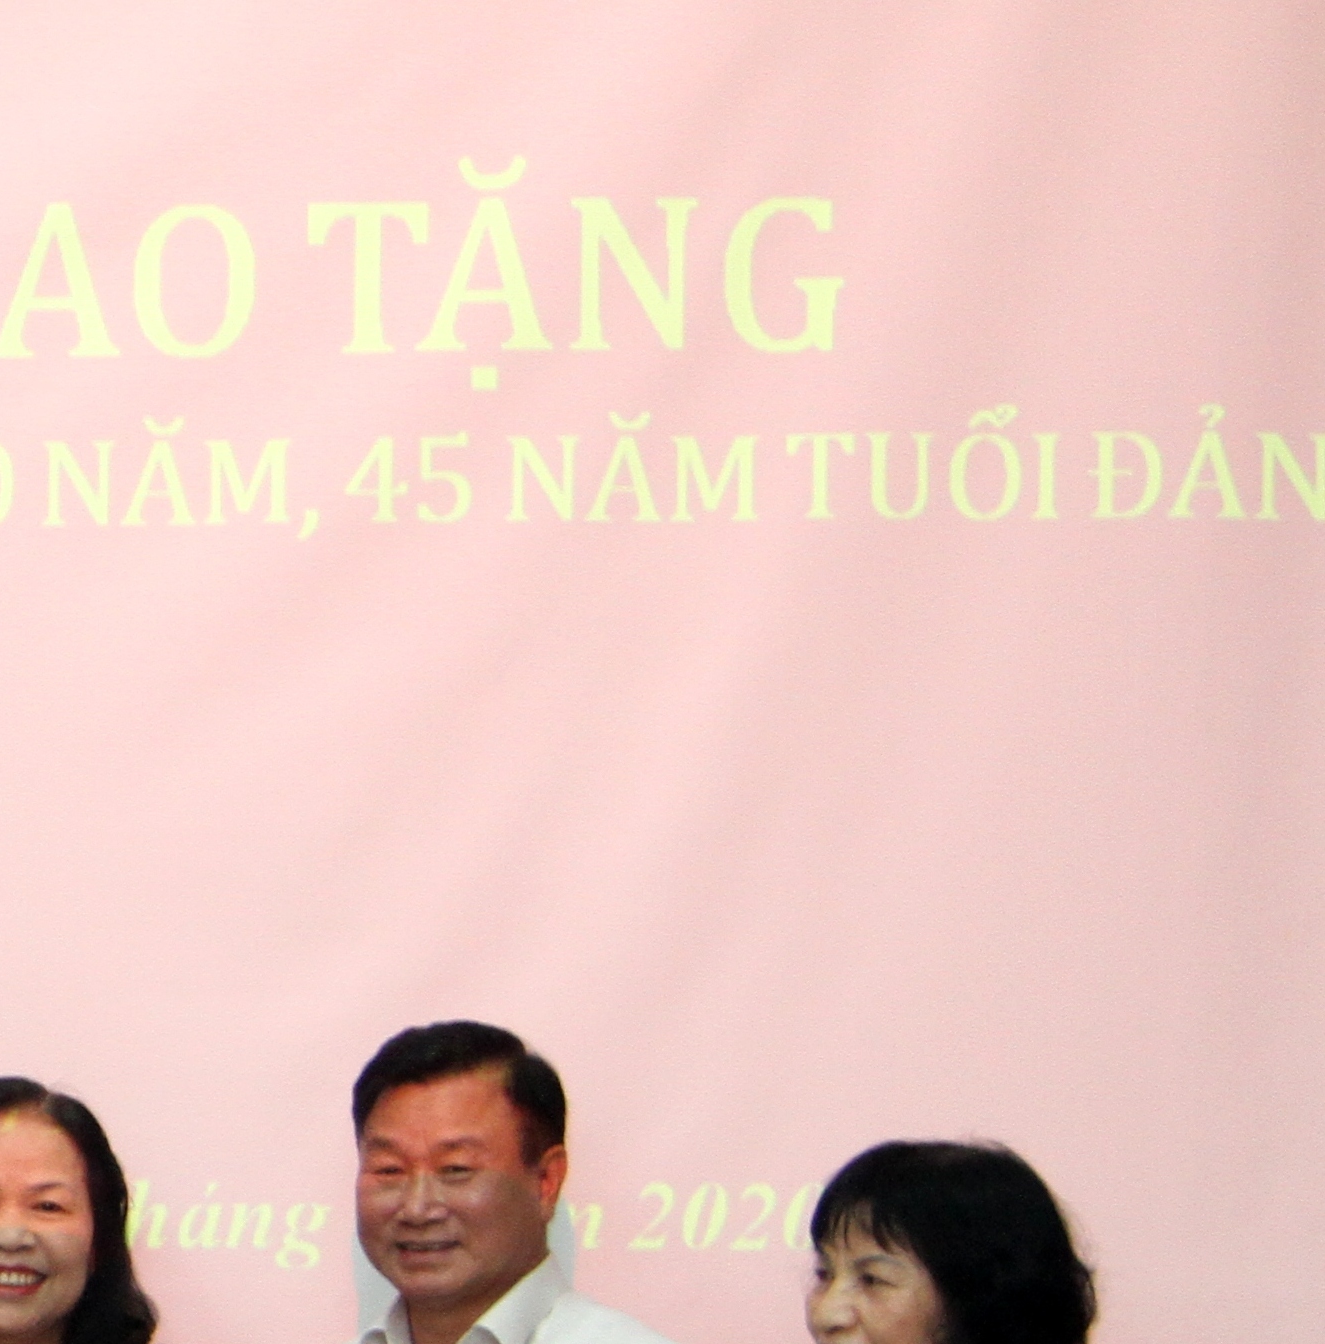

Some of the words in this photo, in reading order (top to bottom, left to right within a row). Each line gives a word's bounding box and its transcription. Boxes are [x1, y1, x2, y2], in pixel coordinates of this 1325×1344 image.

[305, 152, 847, 394] TẶNG
[42, 414, 322, 542] NĂM,
[342, 429, 475, 526] 45
[505, 409, 761, 525] NĂM
[783, 401, 1062, 523] TUỔI
[124, 1179, 332, 1270] háng
